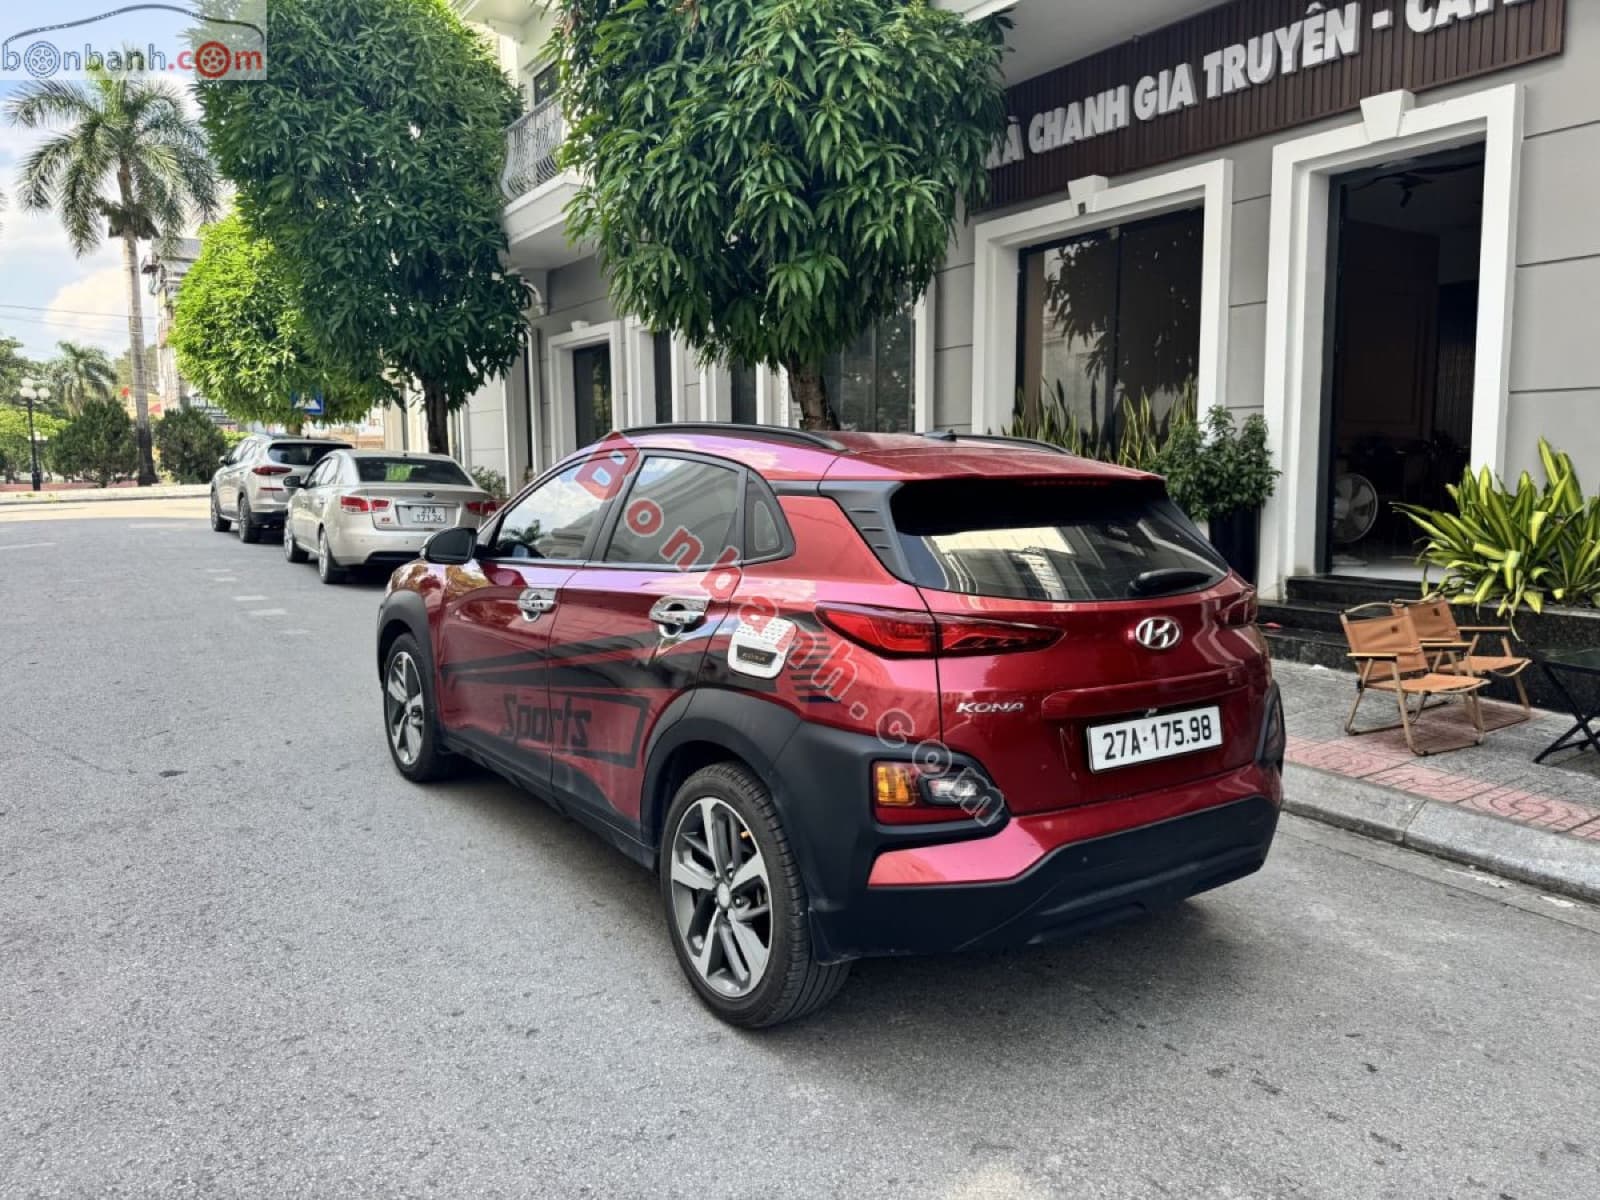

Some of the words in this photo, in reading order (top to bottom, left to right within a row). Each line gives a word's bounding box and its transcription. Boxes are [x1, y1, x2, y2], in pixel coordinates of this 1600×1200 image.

[1028, 84, 1130, 154] CHANH
[1133, 75, 1198, 121] GIA
[1203, 1, 1361, 99] TRUYÊN
[502, 693, 593, 751] Sports
[956, 702, 1025, 713] KONA
[1103, 715, 1212, 760] 27A-175.98
